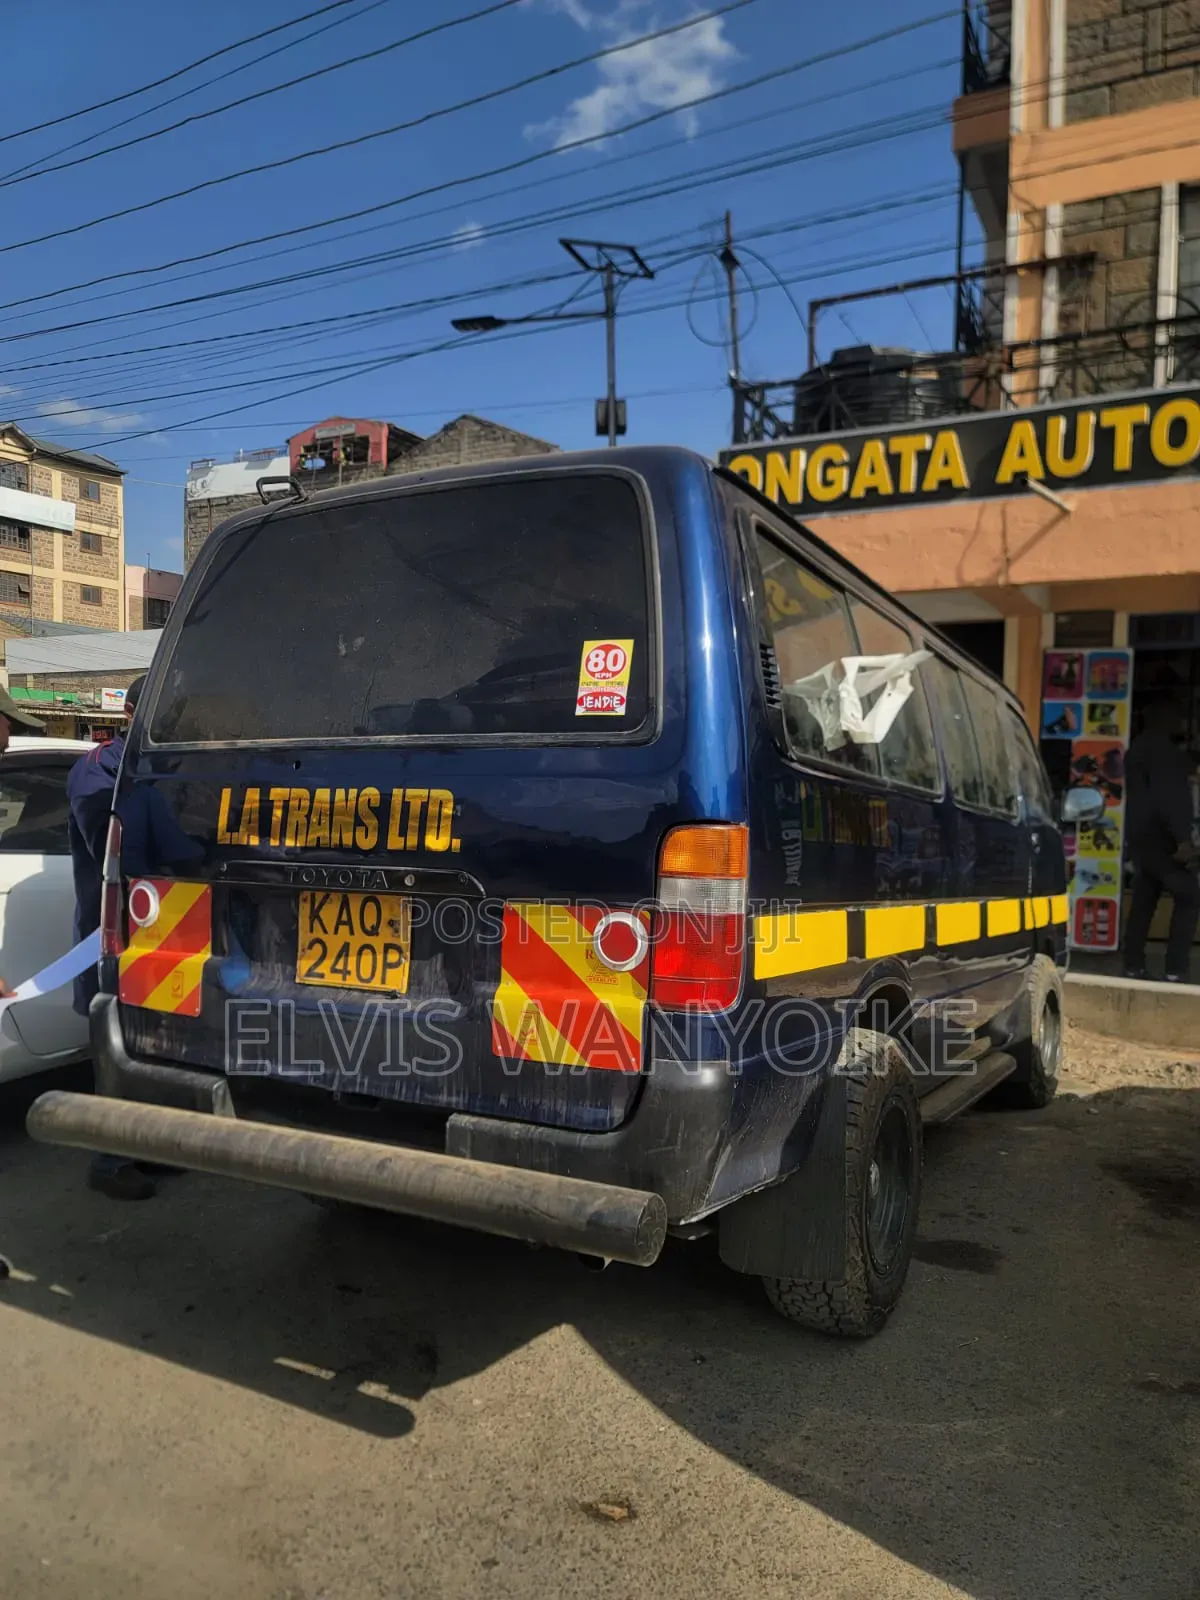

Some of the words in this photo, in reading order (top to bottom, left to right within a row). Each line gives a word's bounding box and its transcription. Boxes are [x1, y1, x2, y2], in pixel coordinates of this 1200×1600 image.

[996, 397, 1200, 484] AUTO
[588, 648, 625, 672] 80
[269, 786, 380, 850] TRANS
[387, 788, 461, 853] LTD.
[285, 866, 389, 889] TOYOTA
[308, 892, 383, 937] KAQ
[304, 937, 404, 985] 240P
